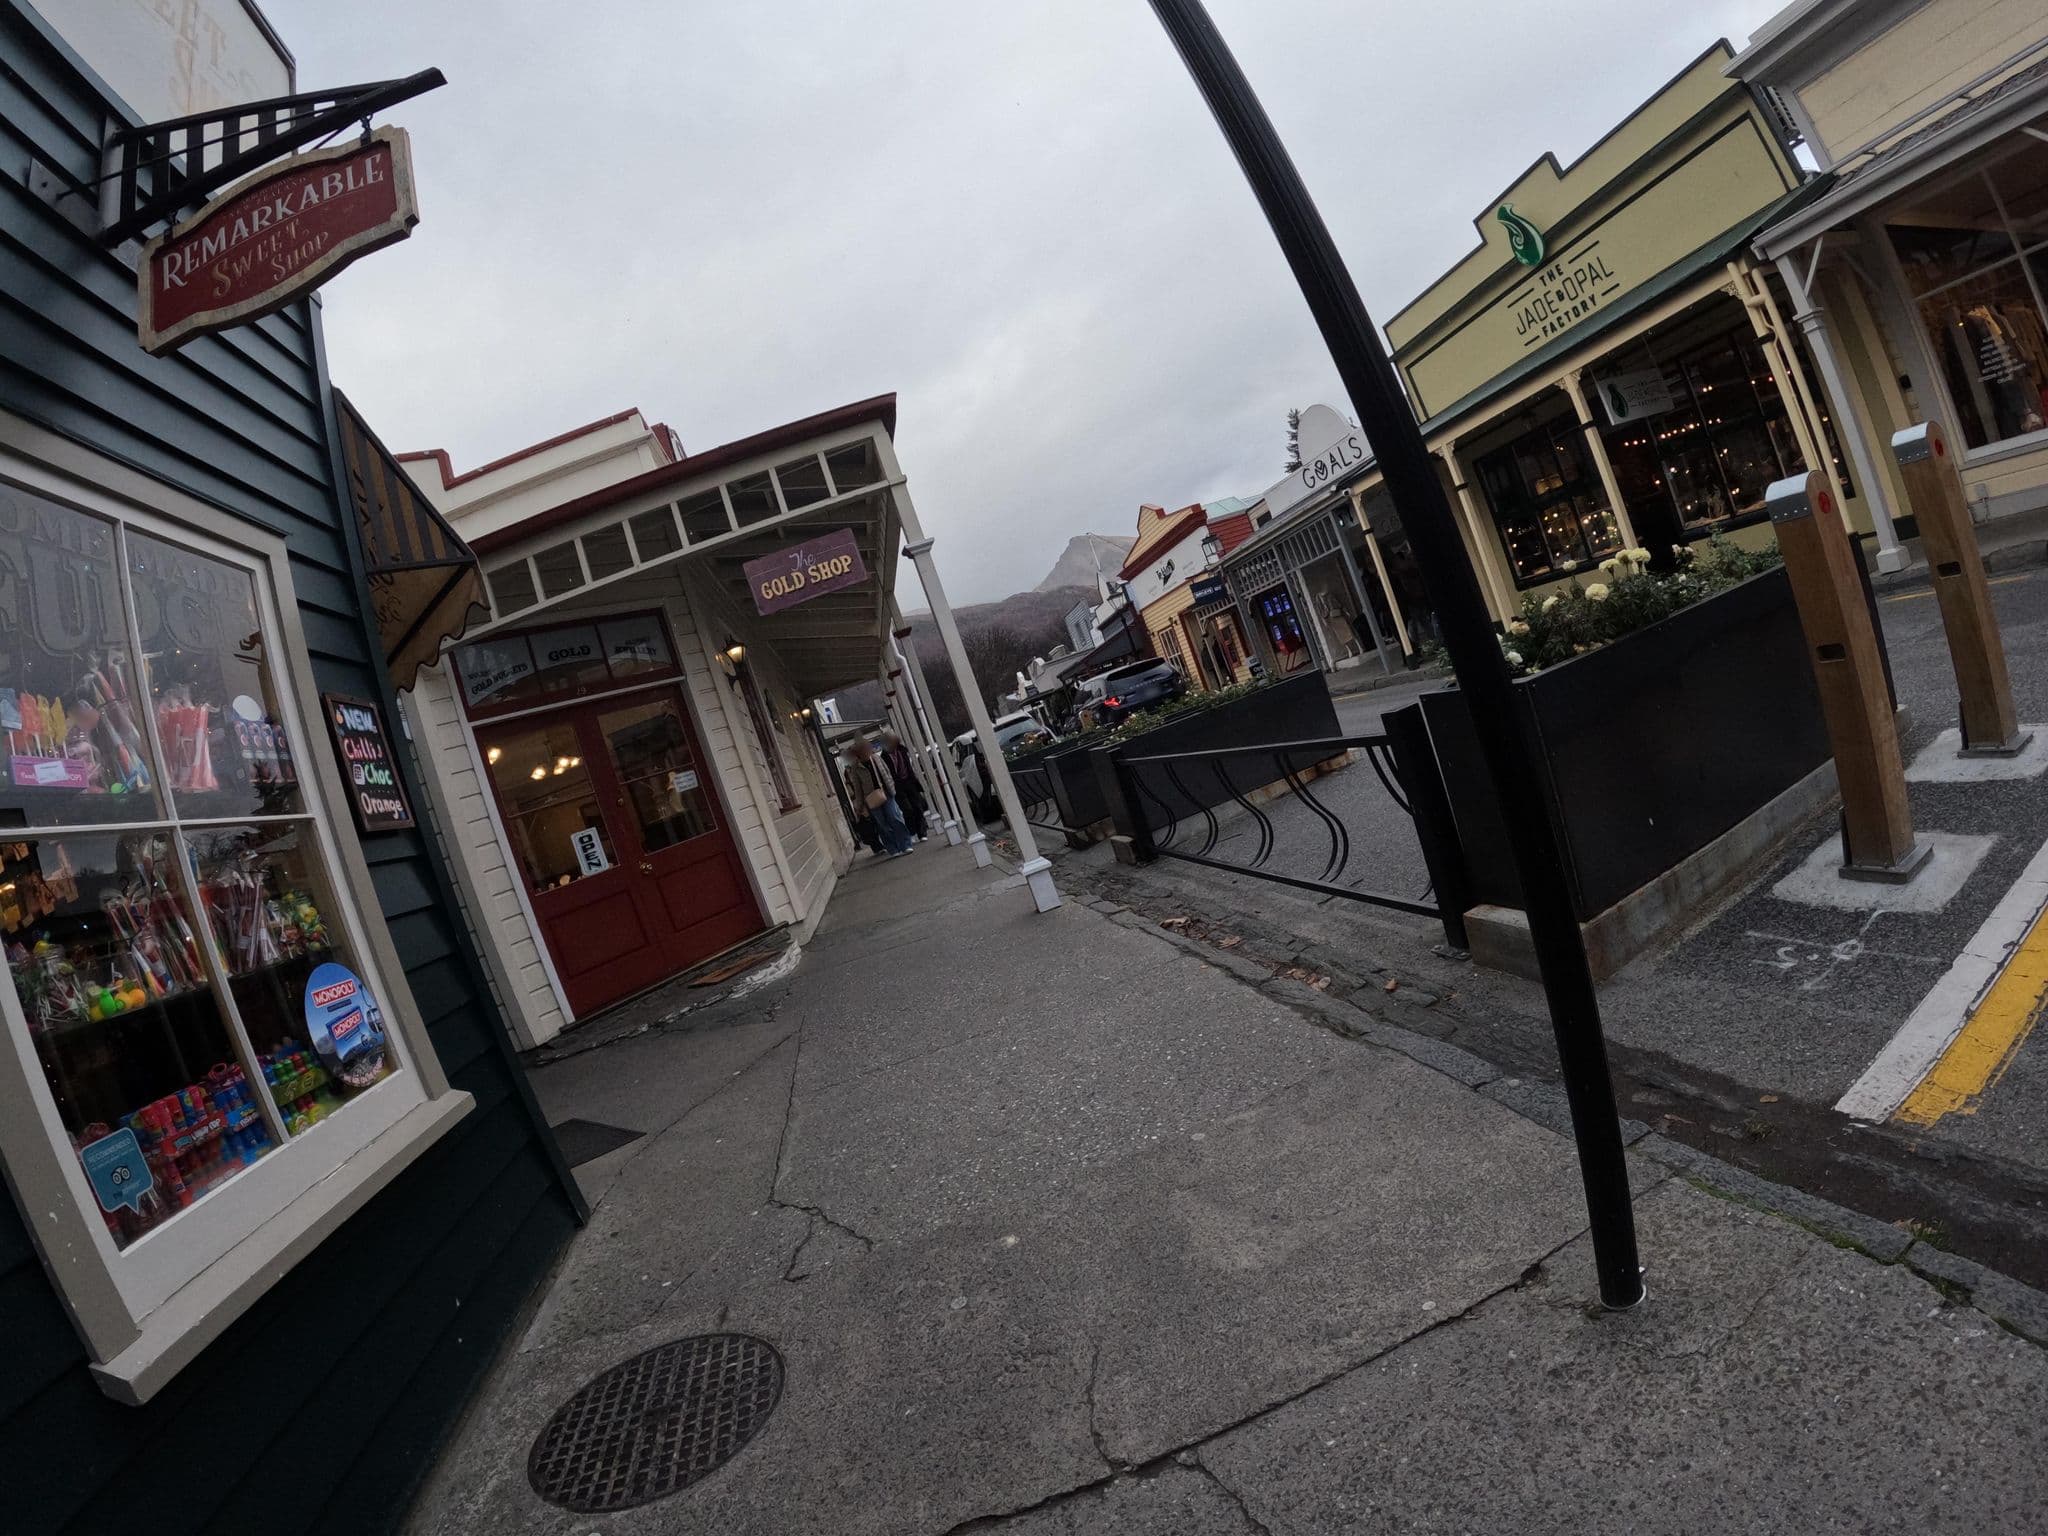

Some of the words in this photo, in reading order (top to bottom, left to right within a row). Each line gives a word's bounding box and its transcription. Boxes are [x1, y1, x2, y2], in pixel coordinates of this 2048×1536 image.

[162, 153, 384, 291] REMARKABLE
[212, 218, 301, 297] SWEET
[271, 231, 329, 281] SHOP
[1538, 263, 1564, 287] THE
[1516, 290, 1559, 336] JADE
[1555, 288, 1565, 302] &
[1562, 256, 1615, 302] OPAL
[1541, 293, 1598, 338] FACTORY
[1302, 436, 1363, 489] GOALS
[760, 570, 806, 600] GOLD
[807, 554, 853, 584] SHOP
[788, 549, 816, 571] The
[547, 644, 592, 662] GOLD
[364, 762, 393, 786] Choc
[360, 791, 404, 820] Orange
[578, 833, 602, 871] OPEN
[313, 981, 354, 1004] MONOPOLY
